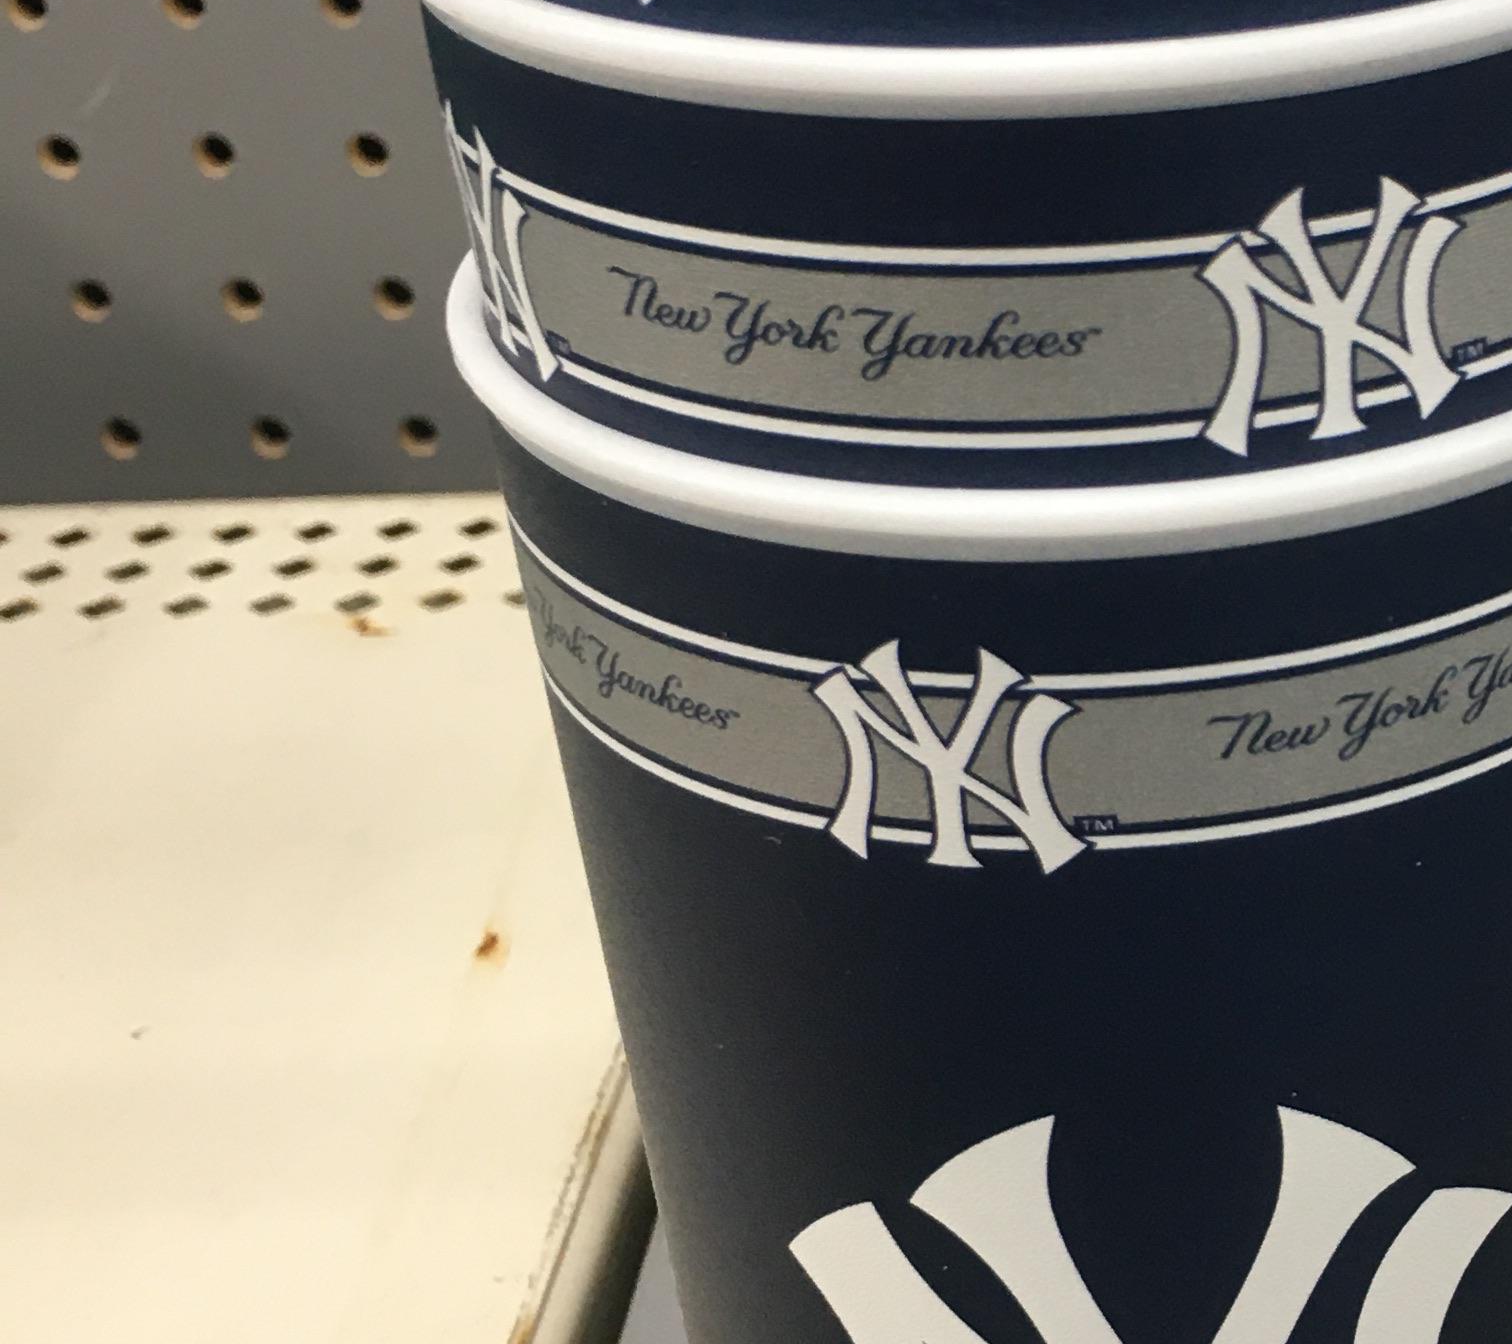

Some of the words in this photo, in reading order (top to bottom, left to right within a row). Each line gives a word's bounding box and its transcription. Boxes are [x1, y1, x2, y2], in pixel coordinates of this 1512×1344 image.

[607, 265, 712, 334] New
[712, 290, 846, 365] York
[850, 306, 1090, 381] Yankees
[585, 632, 730, 731] Yankees
[1206, 712, 1328, 760] New
[1334, 665, 1451, 761] York
